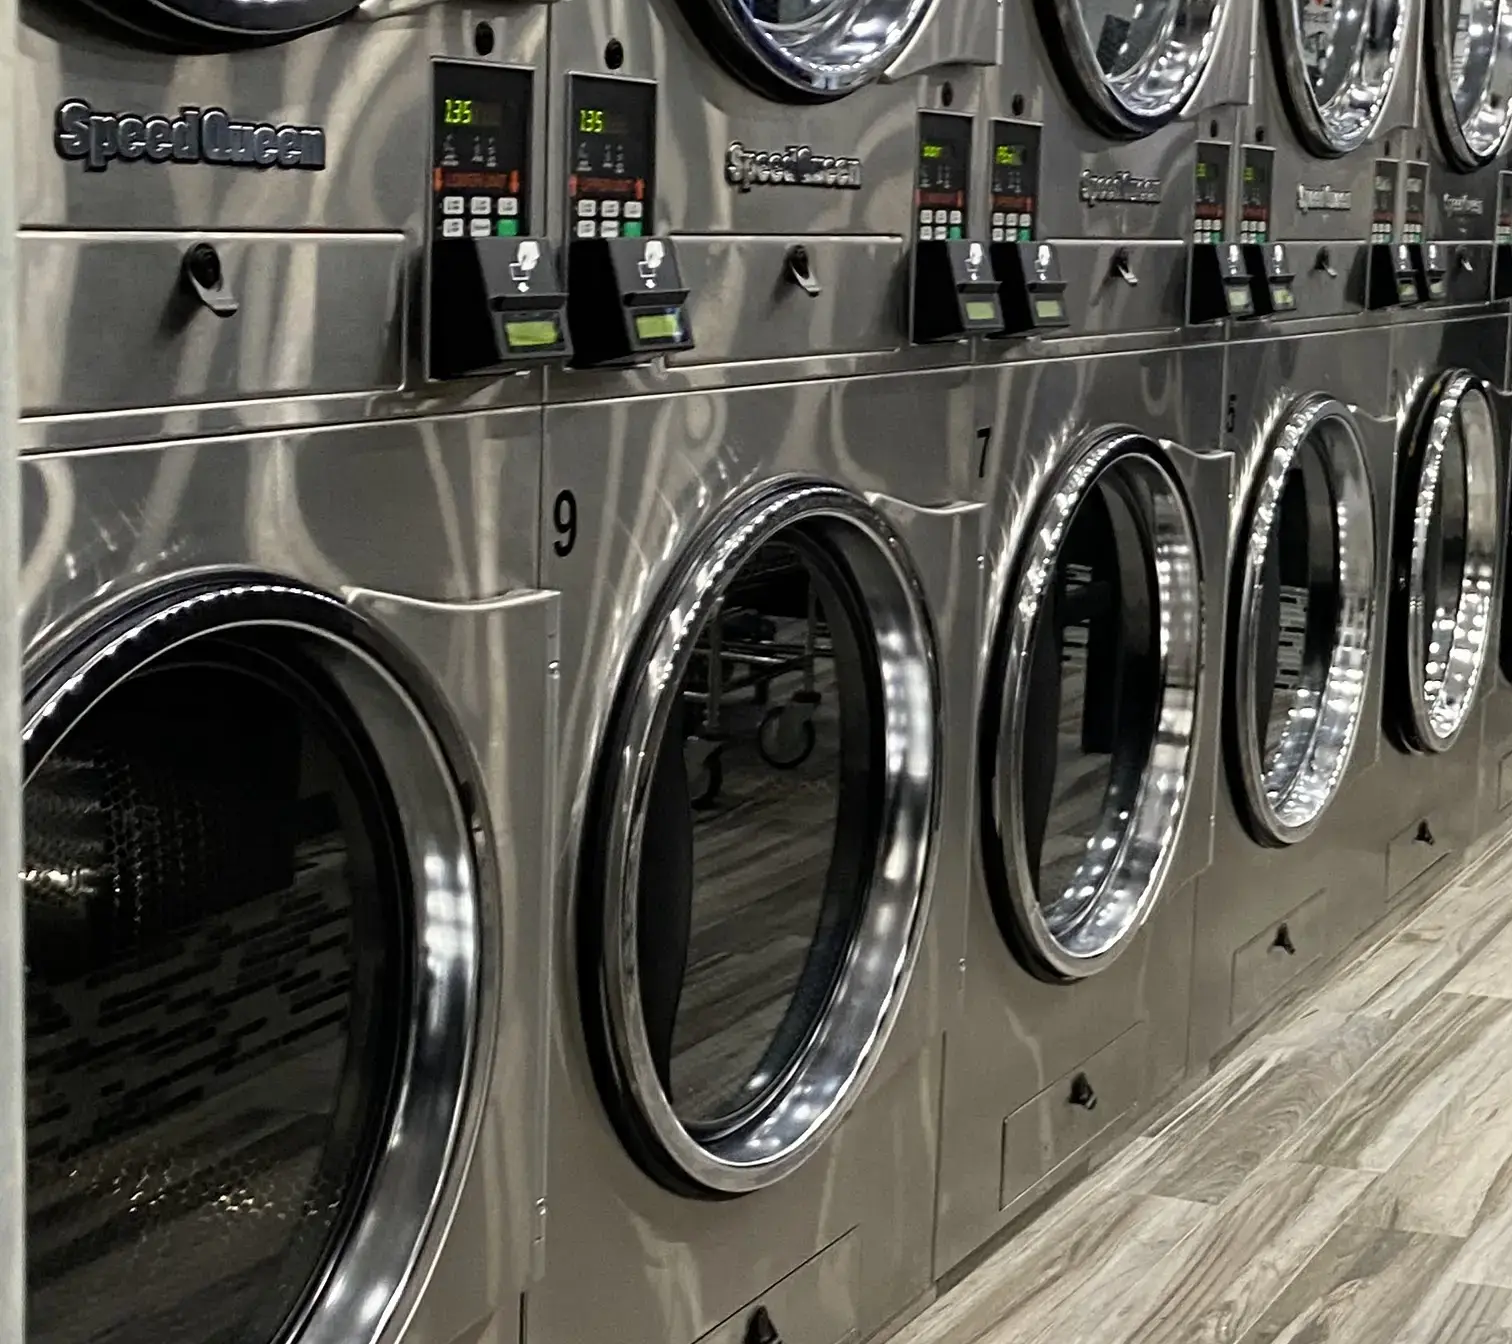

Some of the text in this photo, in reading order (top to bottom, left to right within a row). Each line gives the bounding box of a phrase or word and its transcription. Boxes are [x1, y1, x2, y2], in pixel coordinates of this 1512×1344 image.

[54, 96, 326, 172] Speed Queen
[976, 427, 991, 477] 7
[553, 489, 577, 557] 9
